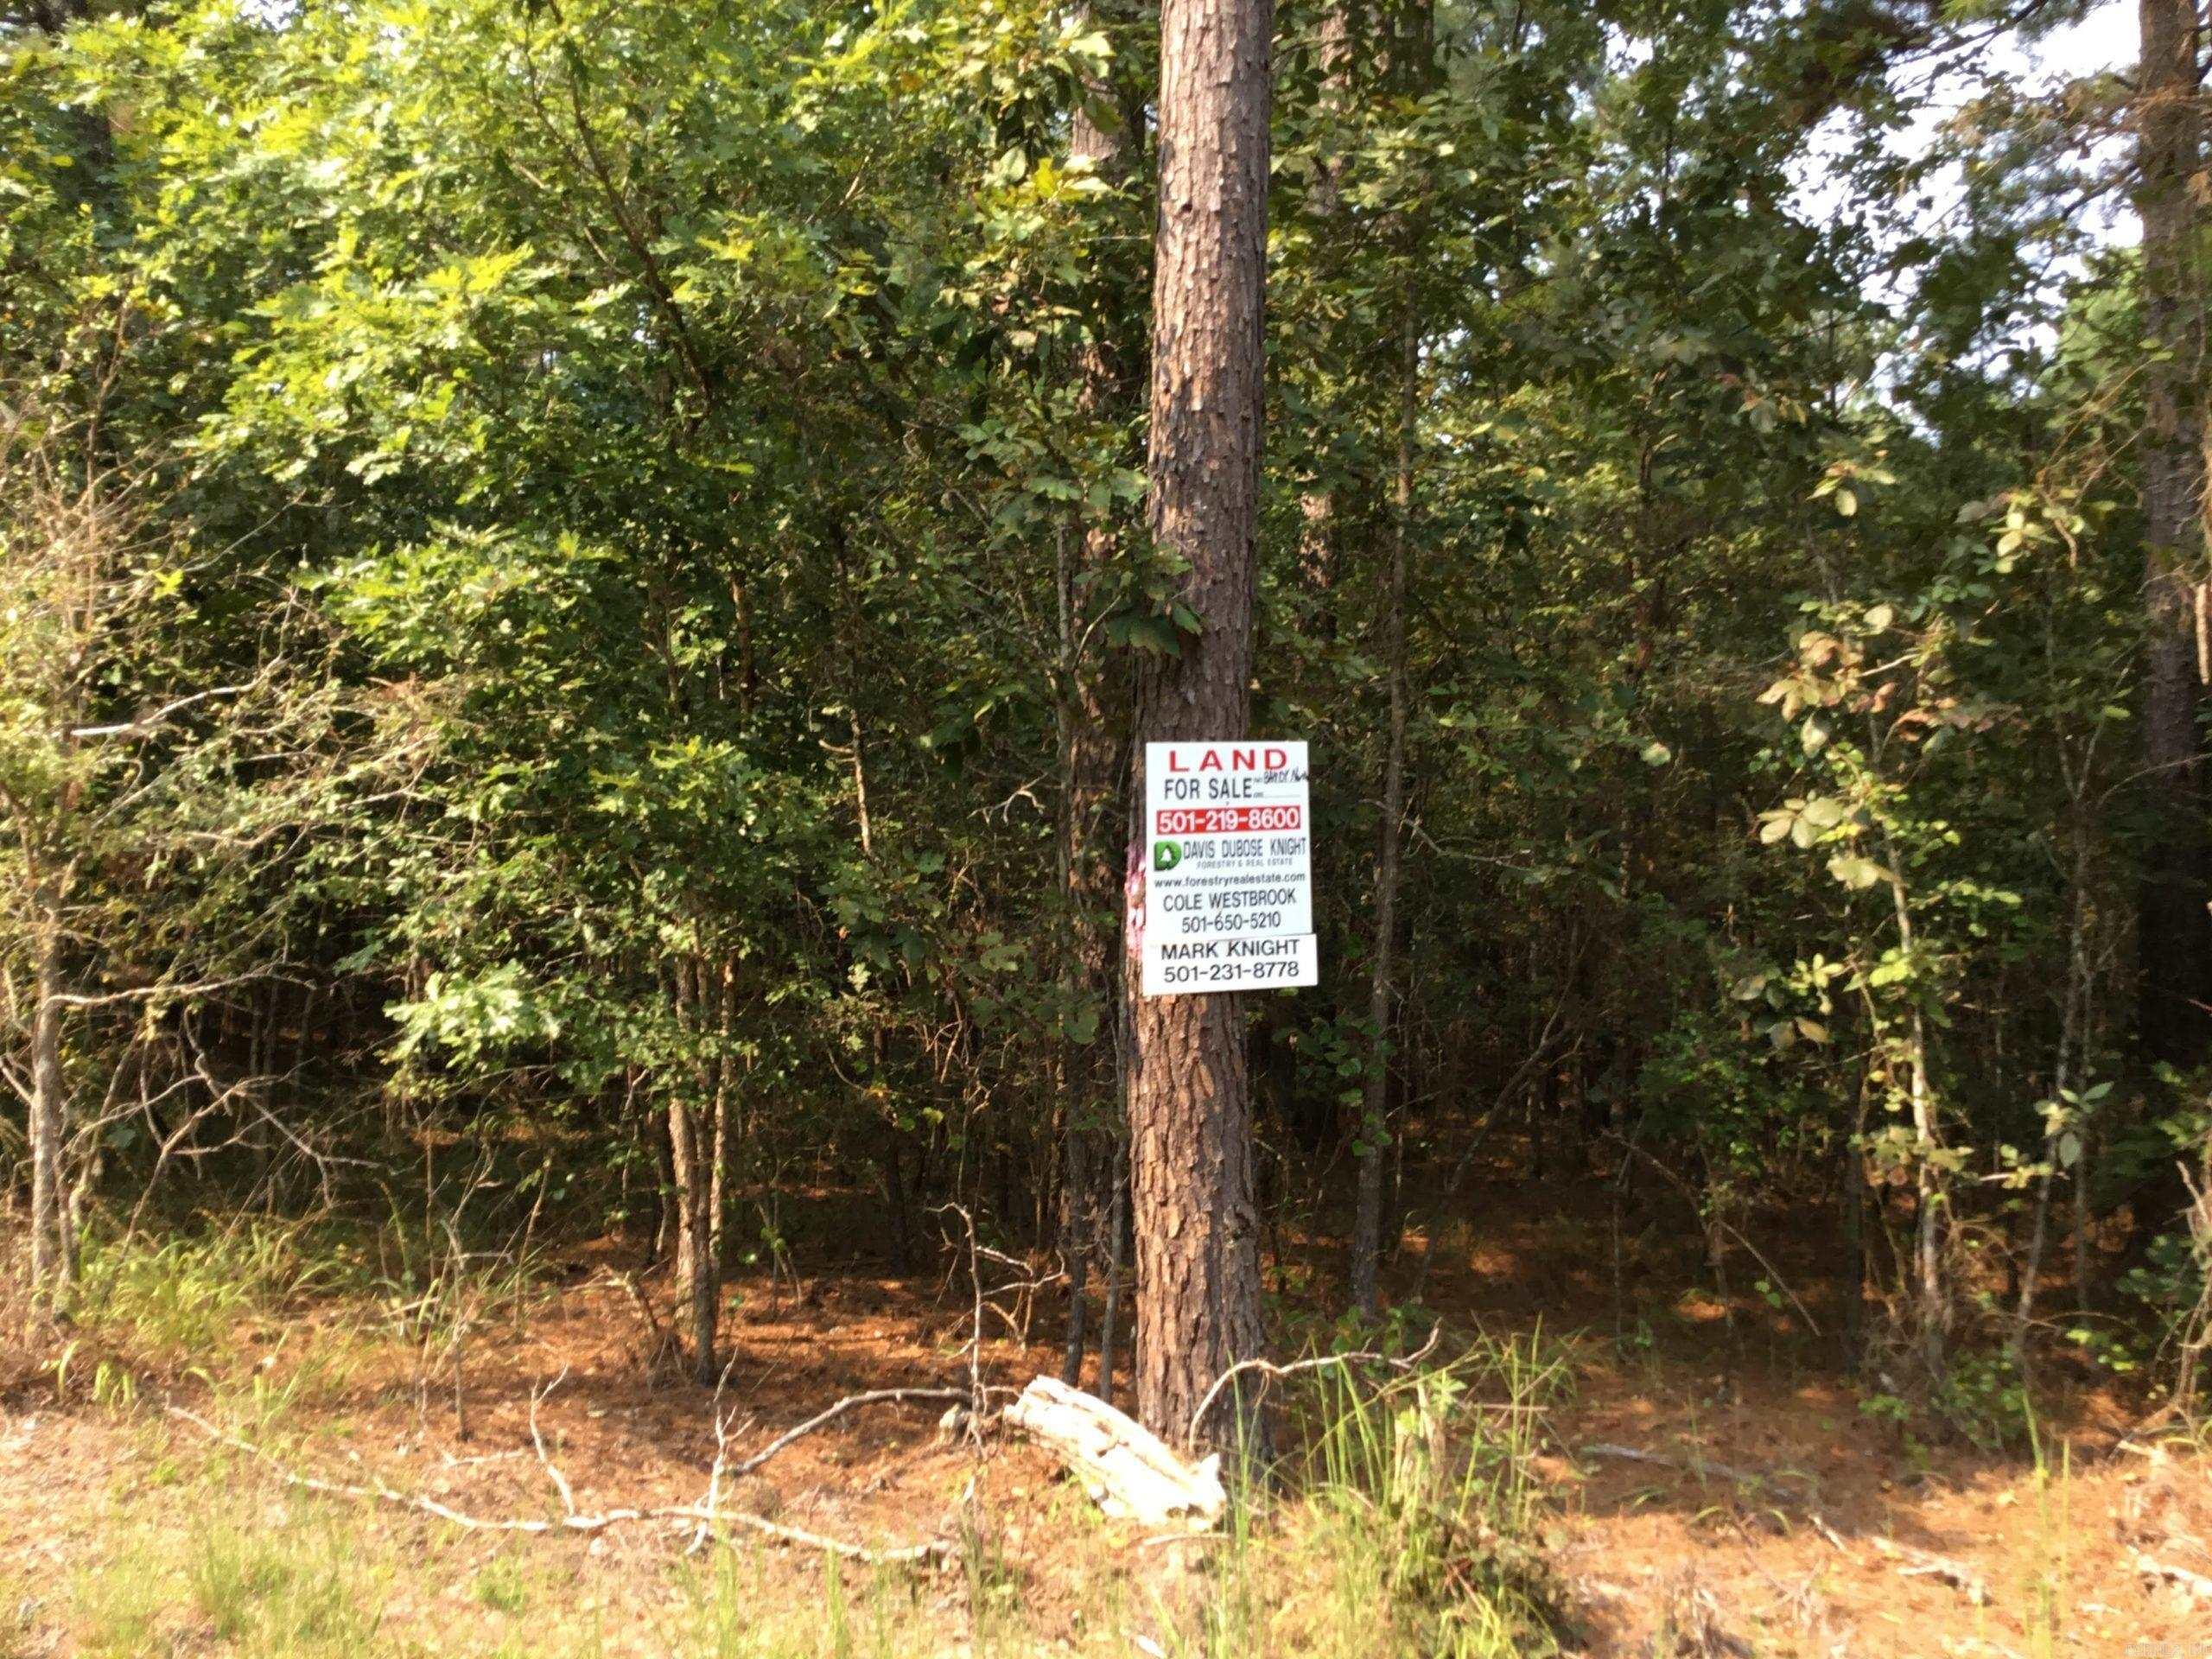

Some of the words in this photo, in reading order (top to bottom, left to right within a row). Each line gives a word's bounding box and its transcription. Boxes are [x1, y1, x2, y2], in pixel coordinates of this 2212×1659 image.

[1169, 748, 1287, 772] LAND
[1164, 779, 1200, 800] FOR
[1209, 778, 1252, 799] SALE
[1159, 807, 1299, 833] 501-219-8600
[1183, 840, 1215, 860] DAVIS
[1222, 839, 1262, 858] DUBOSE
[1270, 837, 1306, 855] KNIGHT
[1196, 860, 1236, 869] FORESTRY
[1246, 858, 1263, 868] REAL
[1268, 857, 1293, 867] ESTATE
[1154, 873, 1306, 887] www.forestryrealestate.com
[1163, 893, 1202, 912] COLE
[1209, 887, 1297, 908] WESTBROOK
[1181, 911, 1281, 934] 501-650-5210
[1160, 942, 1218, 960] MARK
[1227, 938, 1300, 957] KNIGHT
[1163, 961, 1300, 983] 501-231-8778
